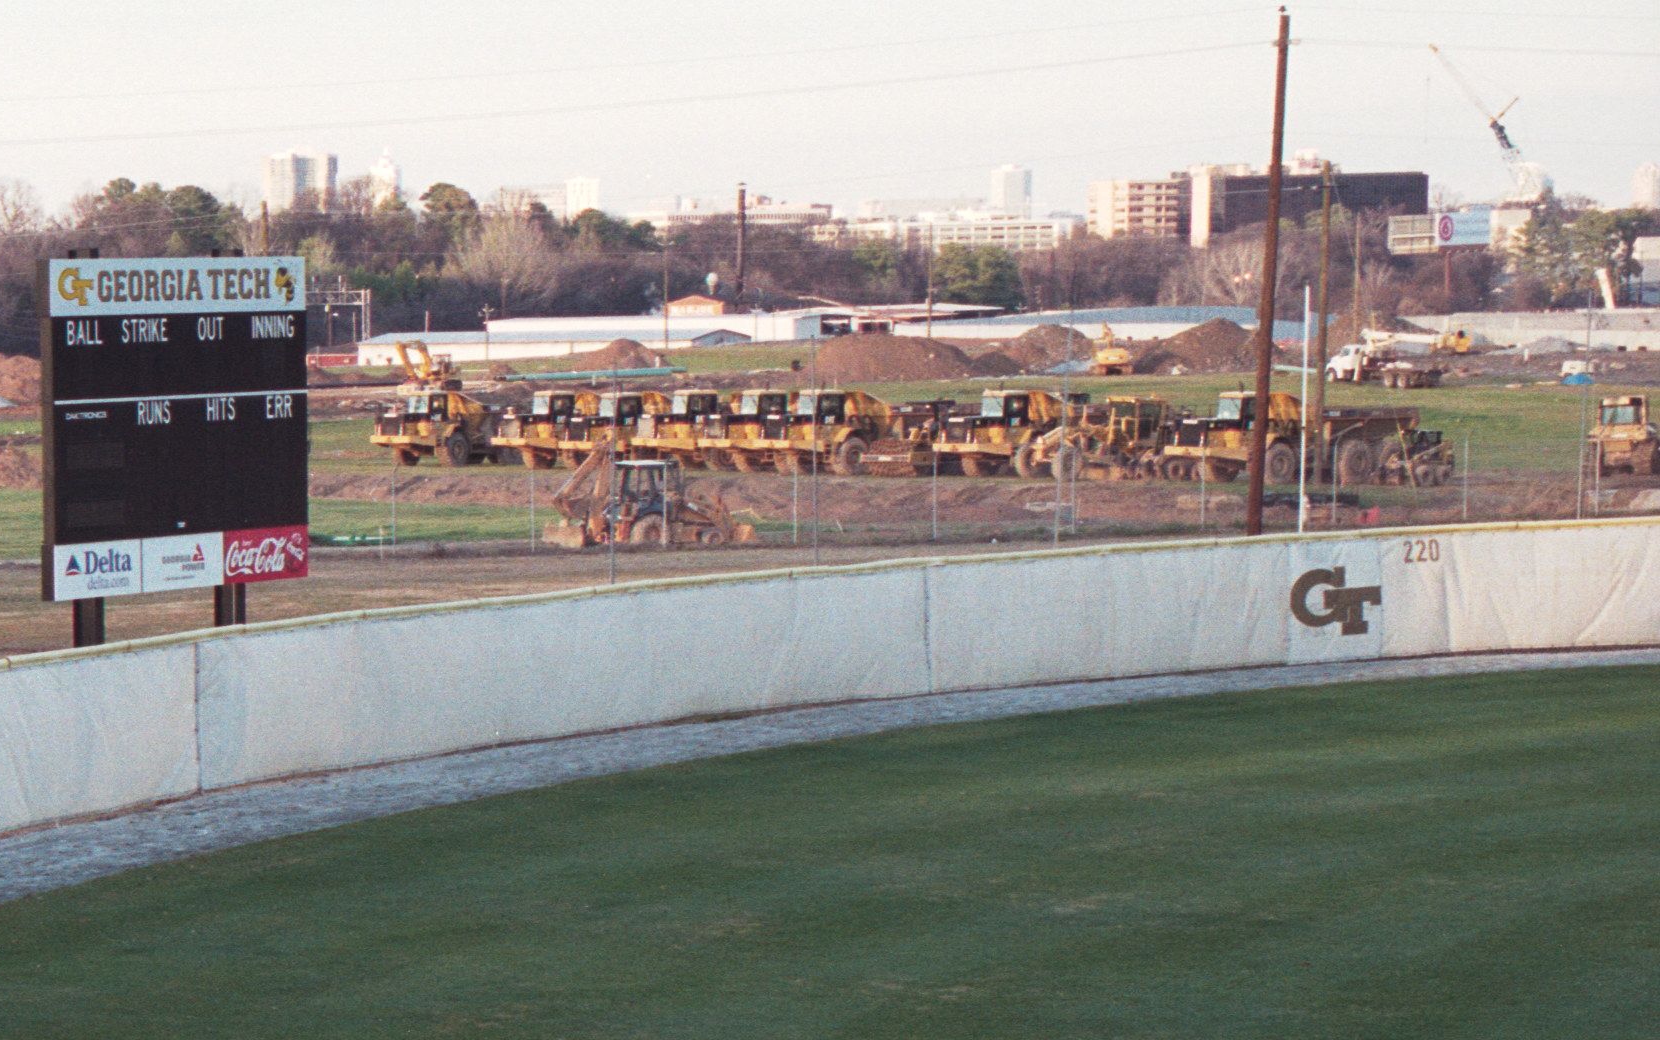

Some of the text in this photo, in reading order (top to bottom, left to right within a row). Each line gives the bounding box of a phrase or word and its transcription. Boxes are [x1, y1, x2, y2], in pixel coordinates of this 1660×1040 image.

[97, 269, 204, 303] GEORGIA
[206, 268, 271, 301] TECH
[66, 315, 295, 346] BALL STRIKE OUT INNING
[137, 394, 293, 425] RUNS HITS ERR
[83, 548, 133, 575] Delta
[225, 536, 288, 577] Coca-Cola
[1402, 538, 1441, 564] 220
[87, 575, 130, 591] delta.com
